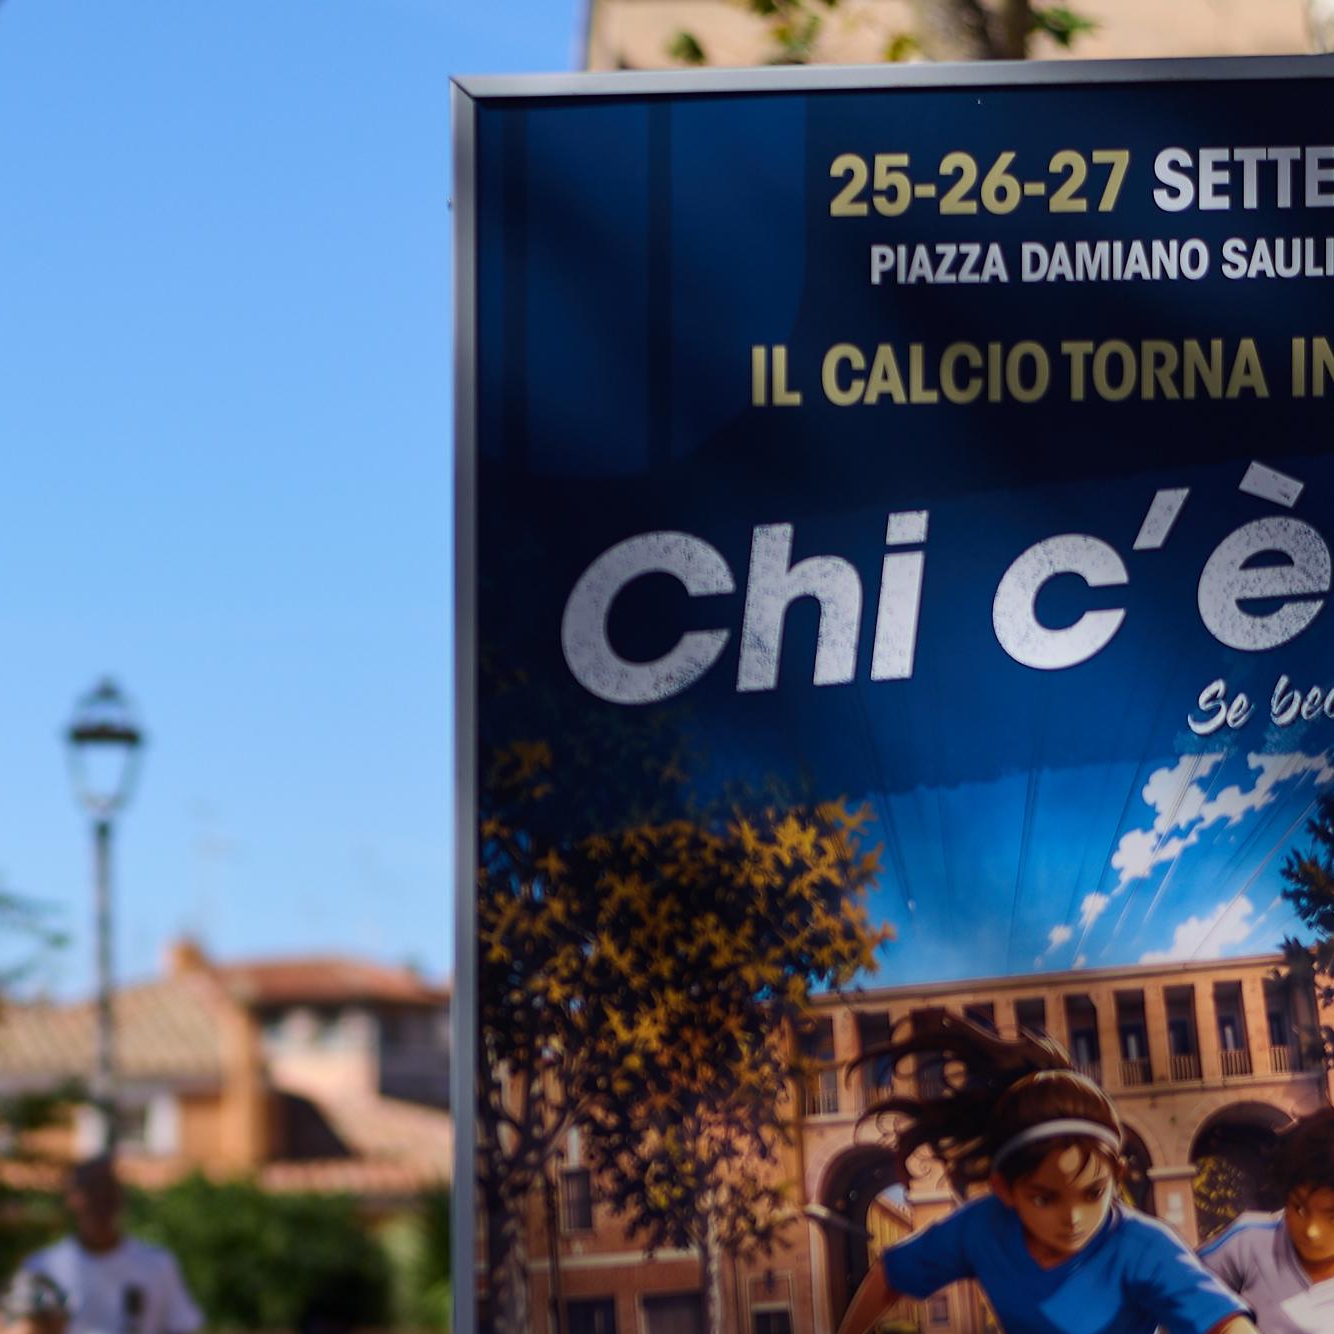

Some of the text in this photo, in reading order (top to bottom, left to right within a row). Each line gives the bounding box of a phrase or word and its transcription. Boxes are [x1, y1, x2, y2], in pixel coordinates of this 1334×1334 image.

[829, 146, 1334, 216] 25-26-27 SETTE
[870, 236, 1334, 285] PIAZZA DAMIANO SAULI
[751, 336, 1334, 407] IL CALCIO TORNA IN
[560, 460, 1333, 706] Chi c'è
[1187, 678, 1256, 736] Se
